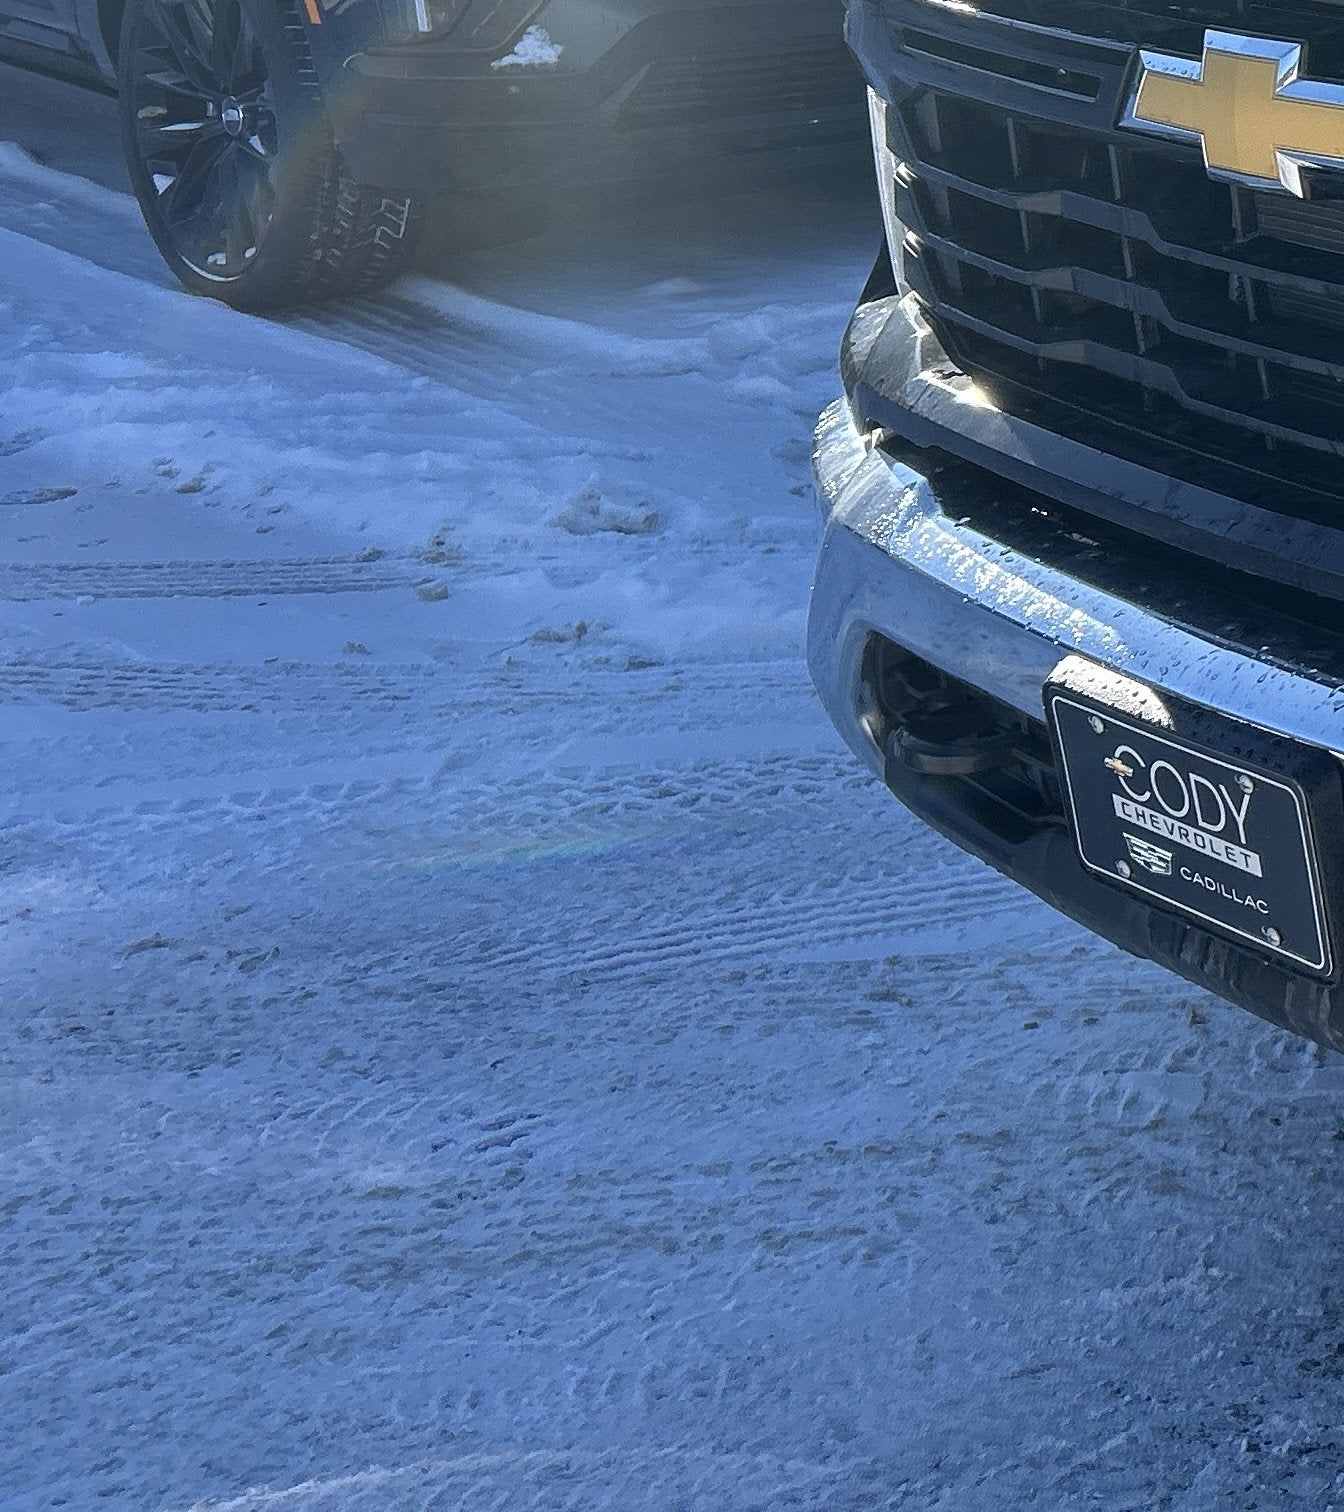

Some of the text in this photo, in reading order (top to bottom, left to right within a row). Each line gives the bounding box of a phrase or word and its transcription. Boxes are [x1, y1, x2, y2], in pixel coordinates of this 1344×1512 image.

[1112, 744, 1251, 845] CODY
[1120, 800, 1254, 871] CHEVROLET
[1179, 865, 1270, 915] CADILLAC
